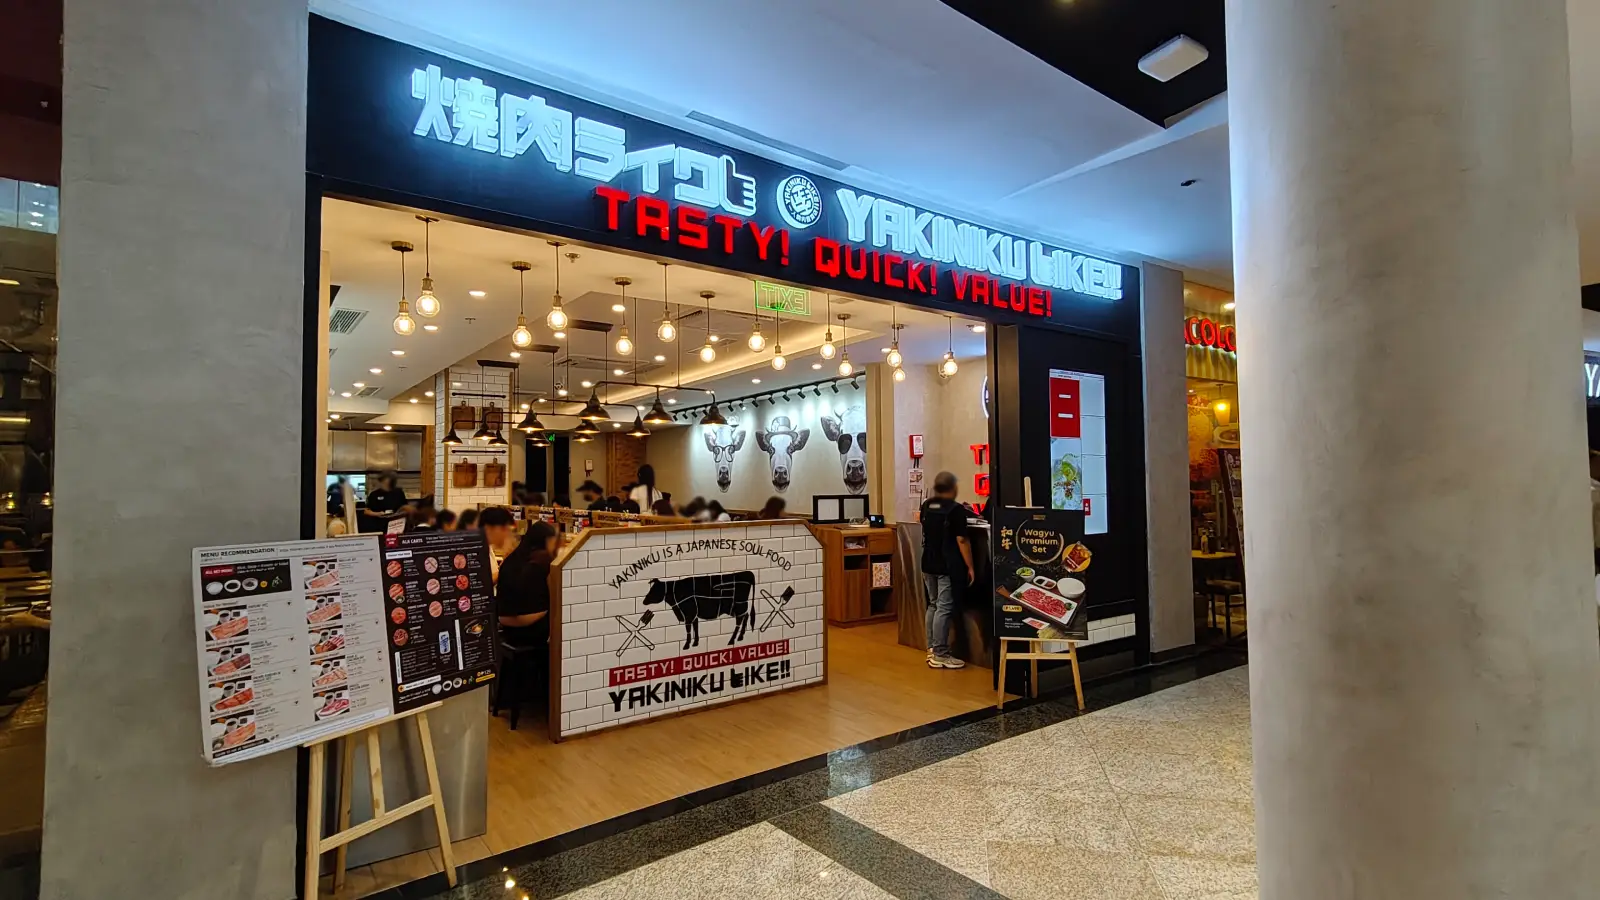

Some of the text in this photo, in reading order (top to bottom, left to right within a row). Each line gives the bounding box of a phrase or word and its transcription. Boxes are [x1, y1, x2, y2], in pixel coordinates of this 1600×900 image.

[593, 185, 1053, 317] TASTY! QUICK! VALUE!
[836, 188, 1124, 301] YAKINIKU LIKE!!
[200, 547, 276, 559] MENU RECOMMENDATION
[1020, 537, 1058, 546] Premium
[1024, 528, 1055, 539] Wagyu
[1032, 545, 1047, 554] Set
[608, 538, 792, 590] YAKINIKU IS A JAPANESE SOUL FOOD
[613, 641, 788, 683] TASTY! QUICK! VALUE!
[608, 659, 791, 713] YAKINIKU LIKE!!
